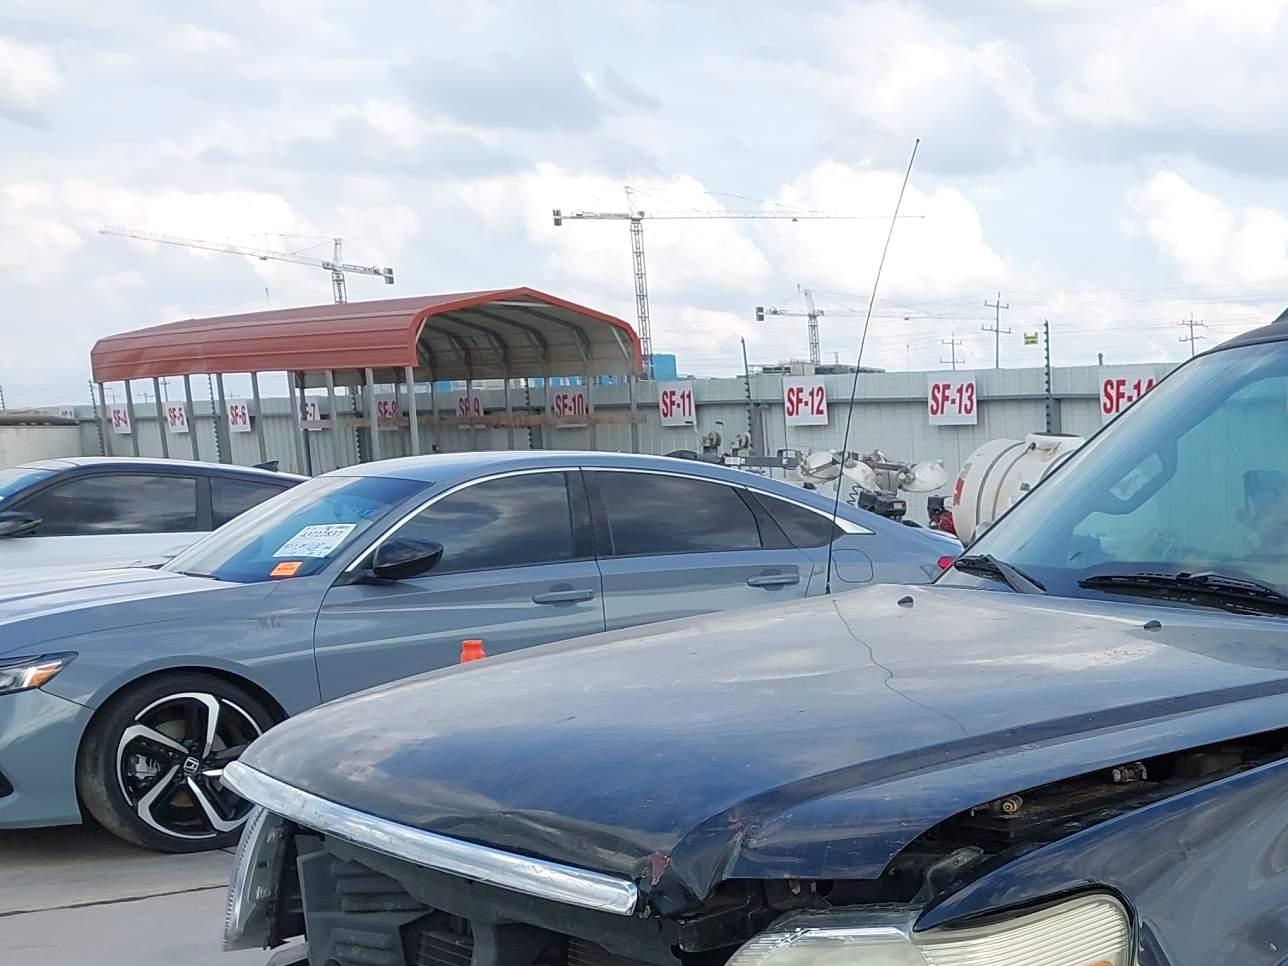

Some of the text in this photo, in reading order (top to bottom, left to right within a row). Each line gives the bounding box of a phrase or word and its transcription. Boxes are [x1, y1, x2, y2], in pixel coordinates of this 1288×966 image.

[458, 397, 481, 417] SF9
[661, 389, 693, 418] SF-11
[786, 385, 825, 416] SF-12
[930, 382, 975, 415] SF-13
[112, 409, 129, 428] SF-4
[167, 407, 185, 427] SF-5
[229, 405, 247, 426] SF-6
